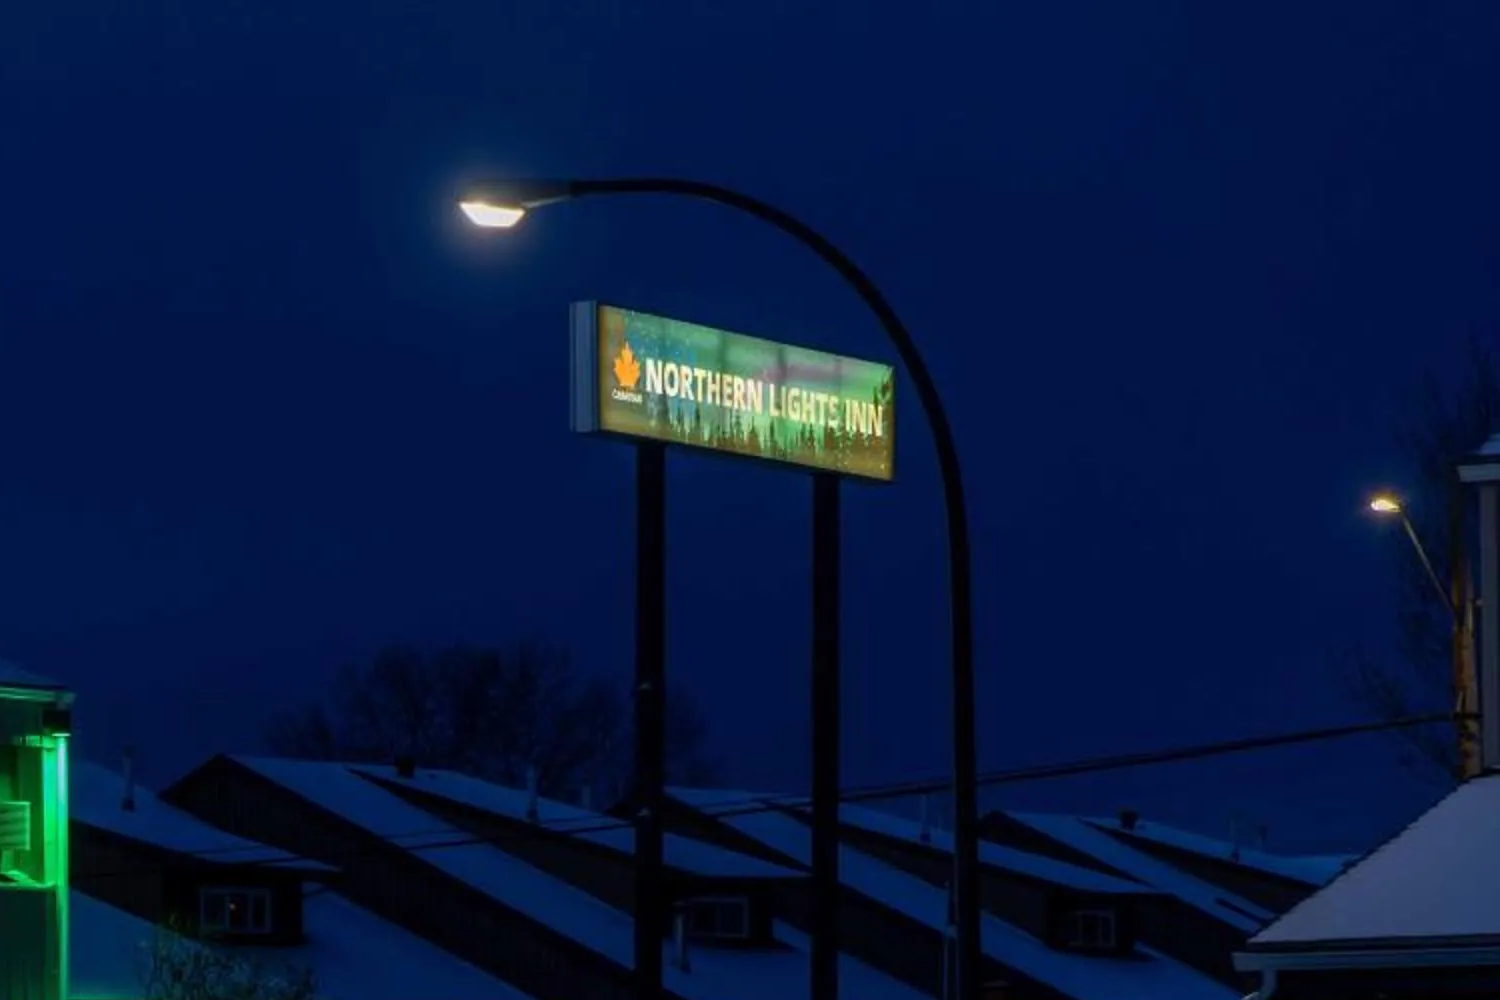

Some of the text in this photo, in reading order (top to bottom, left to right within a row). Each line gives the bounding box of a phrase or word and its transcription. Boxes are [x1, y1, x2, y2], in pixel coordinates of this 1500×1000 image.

[645, 357, 883, 437] NORTHERN LIGHTS INN
